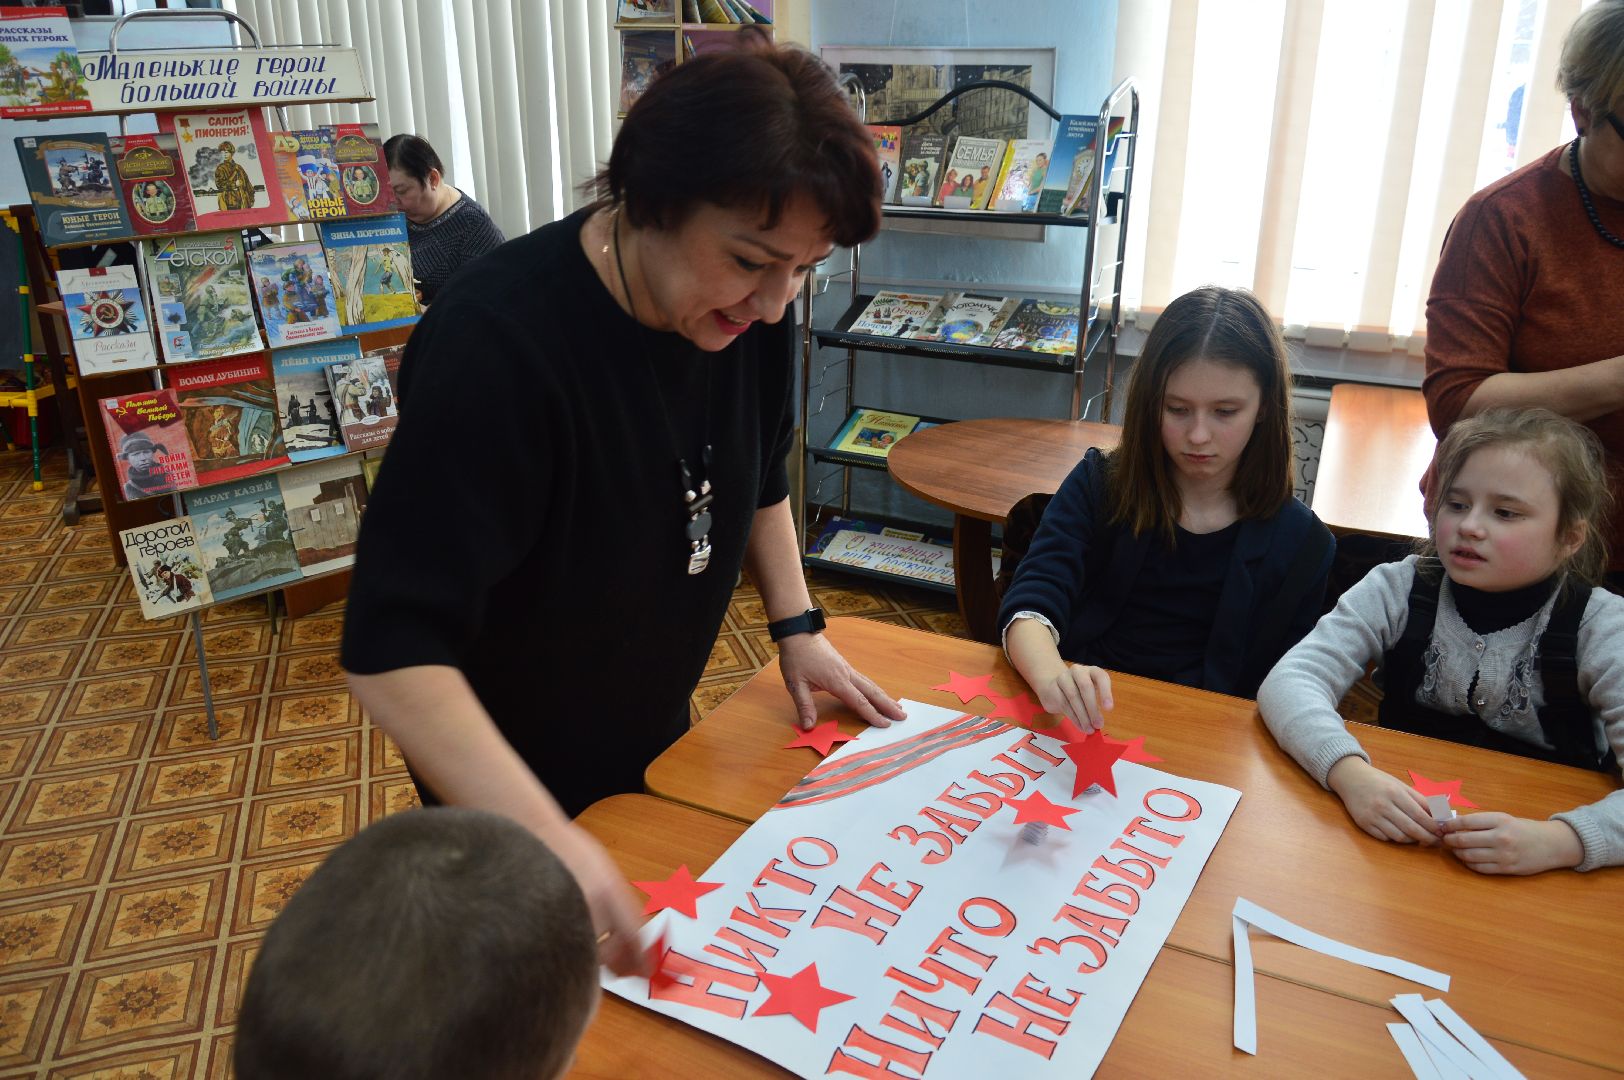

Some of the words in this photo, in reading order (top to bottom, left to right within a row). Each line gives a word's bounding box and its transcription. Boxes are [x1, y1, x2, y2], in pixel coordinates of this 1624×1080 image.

[83, 54, 239, 81] Маленькие
[256, 55, 326, 77] герои
[121, 76, 239, 104] большой
[253, 74, 339, 98] войны
[195, 125, 249, 138] ПИОНЕРИЯ!
[956, 145, 996, 162] СЕМЬЯ
[308, 197, 345, 209] ЮНЫЕ
[310, 206, 347, 219] ГЕРОИ
[62, 214, 90, 224] ЮНЫЕ
[93, 211, 120, 221] ГЕРОИ
[331, 230, 355, 241] ЗИНА
[356, 227, 402, 238] ПОРТНОВА
[281, 358, 309, 368] ЛЁНЯ
[312, 353, 356, 364] ГОЛИКОВ
[180, 374, 215, 388] ВОЛОДЯ
[216, 367, 260, 382] ДУБИНИН
[126, 398, 158, 409] Память
[159, 453, 187, 465] ВОЙНА
[149, 462, 189, 477] ГЛАЗАМИ
[165, 471, 191, 484] ДЕТЕЙ
[193, 492, 230, 508] МАРАТ
[233, 479, 273, 498] КАЗЕЙ
[125, 520, 191, 549] Дорогой
[139, 536, 195, 558] героев
[811, 861, 924, 946] НЕ
[886, 732, 1067, 865] ЗАБЫТ
[1025, 787, 1203, 974] ЗАБЫТО
[648, 835, 839, 1021] НИКТО
[825, 896, 1018, 1080] НИЧТО
[971, 972, 1087, 1061] НЕ
